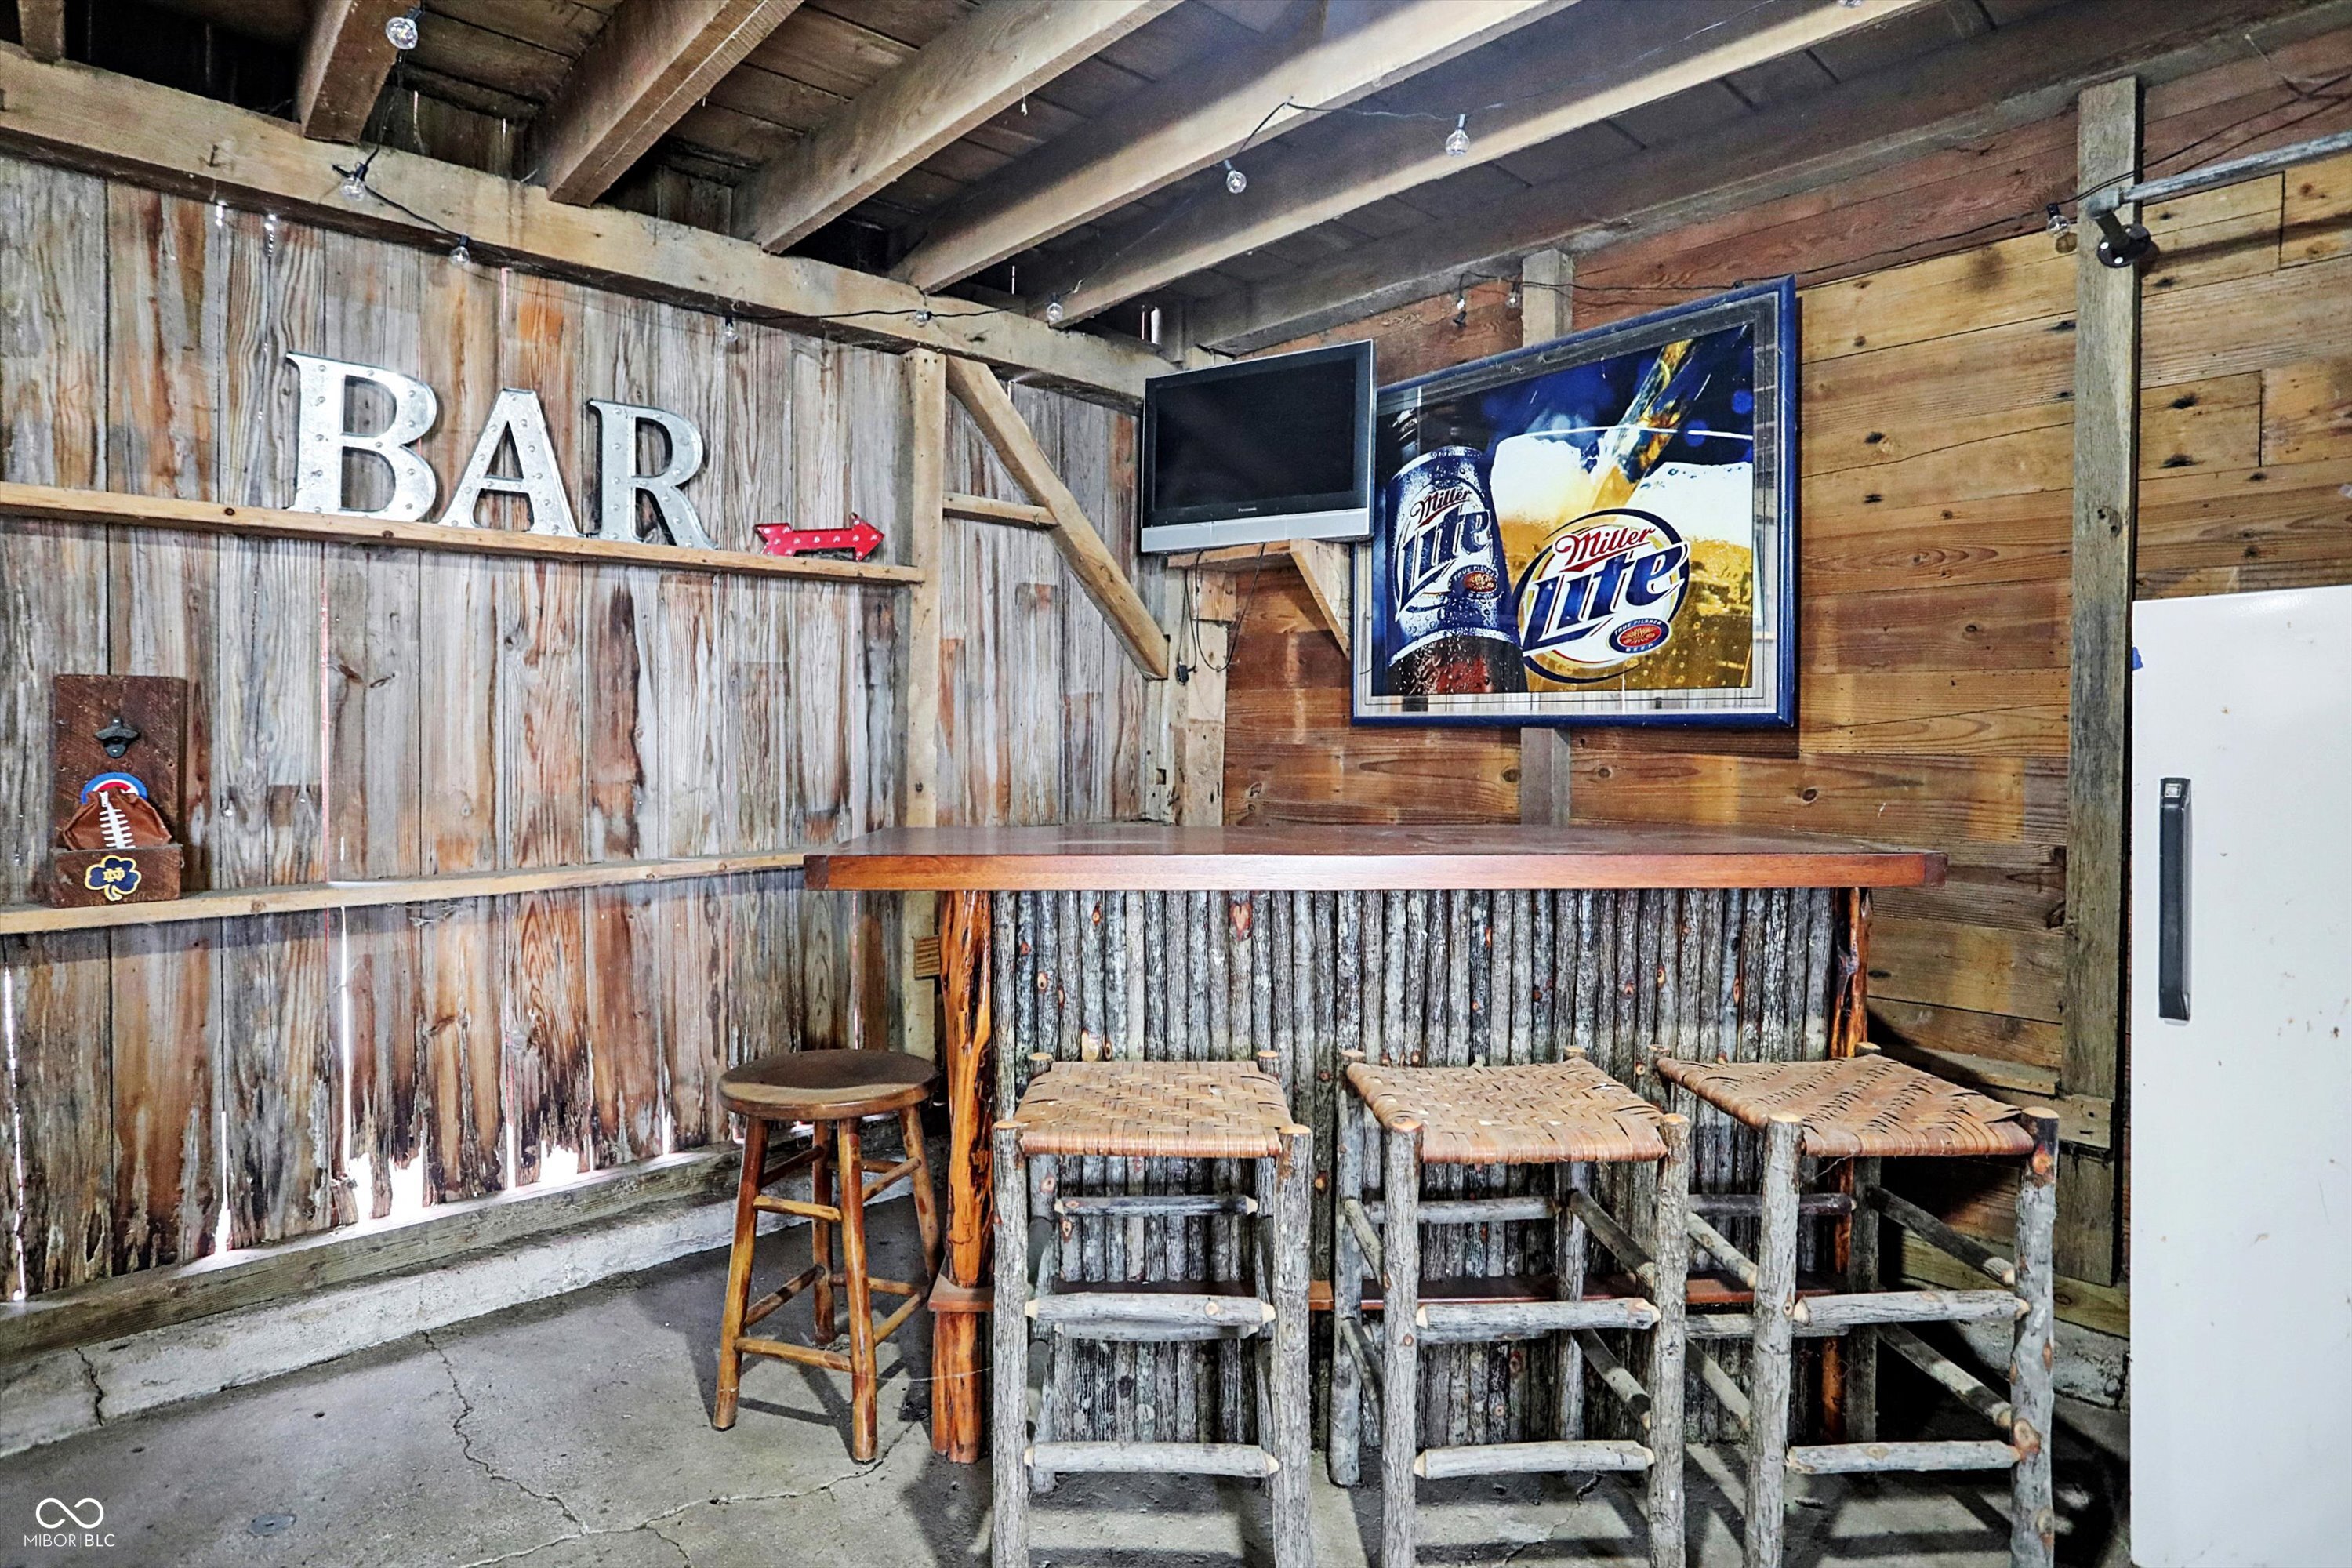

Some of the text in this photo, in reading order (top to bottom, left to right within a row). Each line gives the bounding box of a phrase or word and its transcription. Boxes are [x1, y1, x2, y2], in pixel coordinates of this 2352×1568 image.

[285, 350, 719, 550] BAR
[1410, 488, 1472, 528] Miller
[1396, 506, 1491, 622] Lite
[1555, 527, 1657, 573] Miller
[1522, 541, 1690, 657] Lite
[1614, 623, 1632, 636] TRUE
[1625, 643, 1653, 652] BEER
